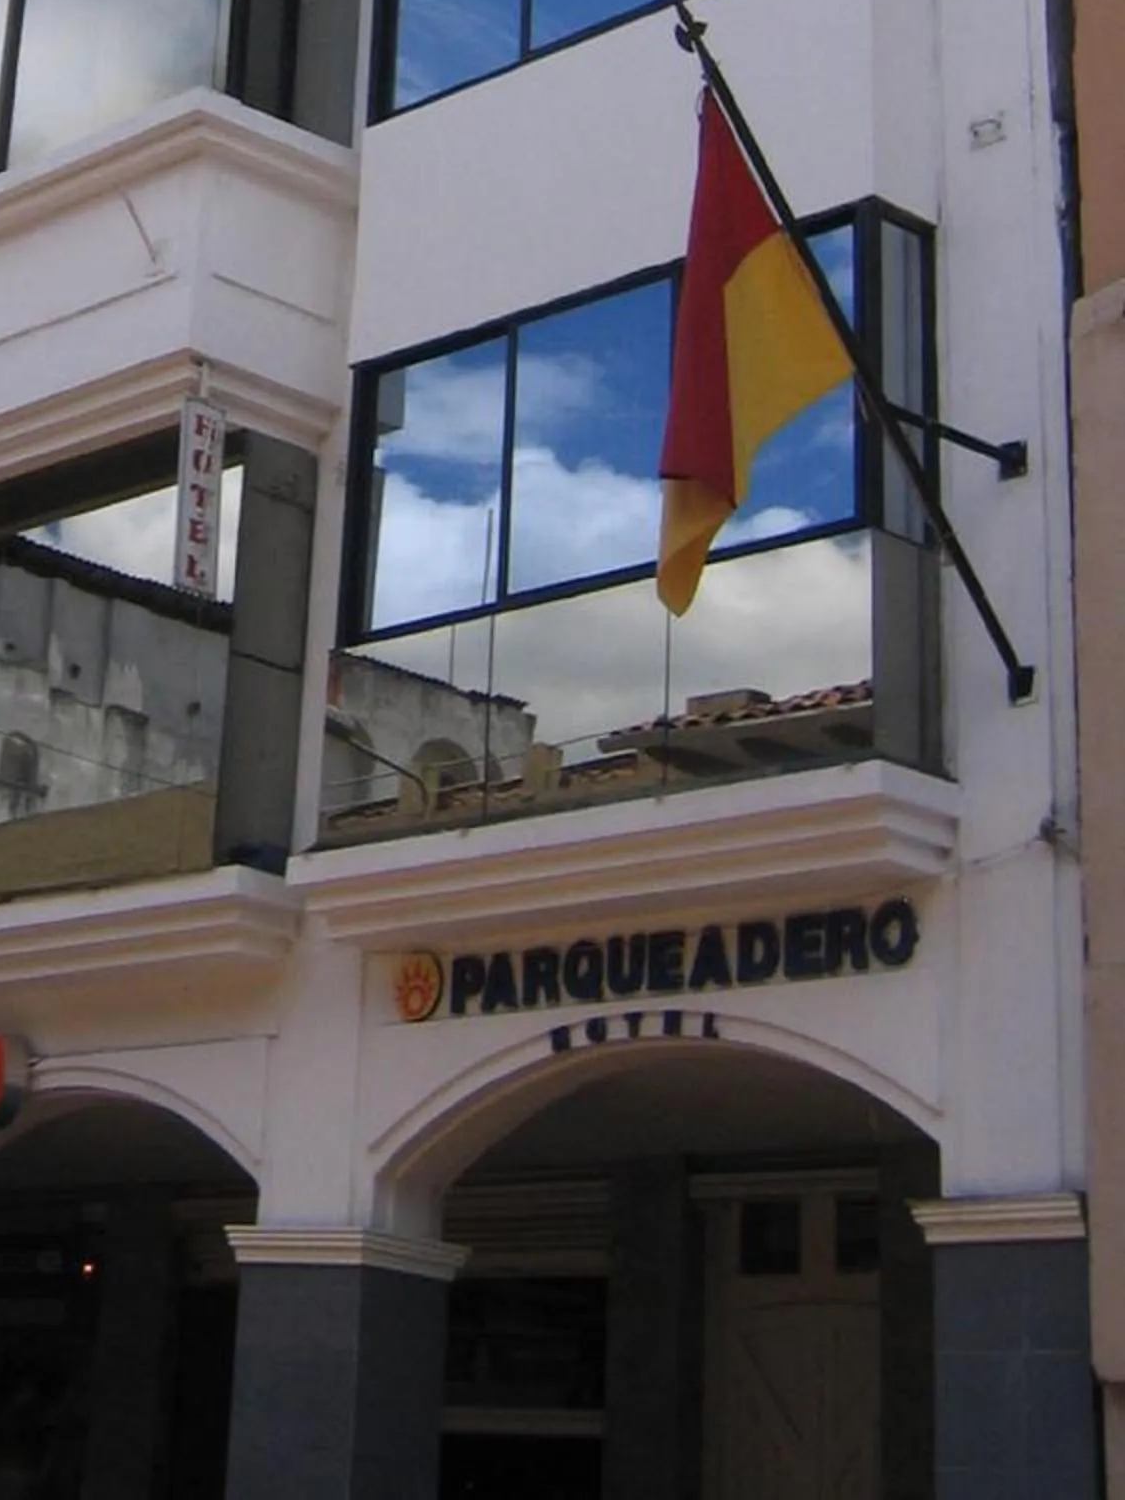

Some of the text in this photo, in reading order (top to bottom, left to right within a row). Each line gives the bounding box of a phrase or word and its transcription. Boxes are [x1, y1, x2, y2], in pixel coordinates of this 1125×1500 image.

[185, 413, 218, 582] HOTEL
[449, 897, 921, 1016] PARQUEADERO
[549, 1009, 720, 1053] HOTEL
